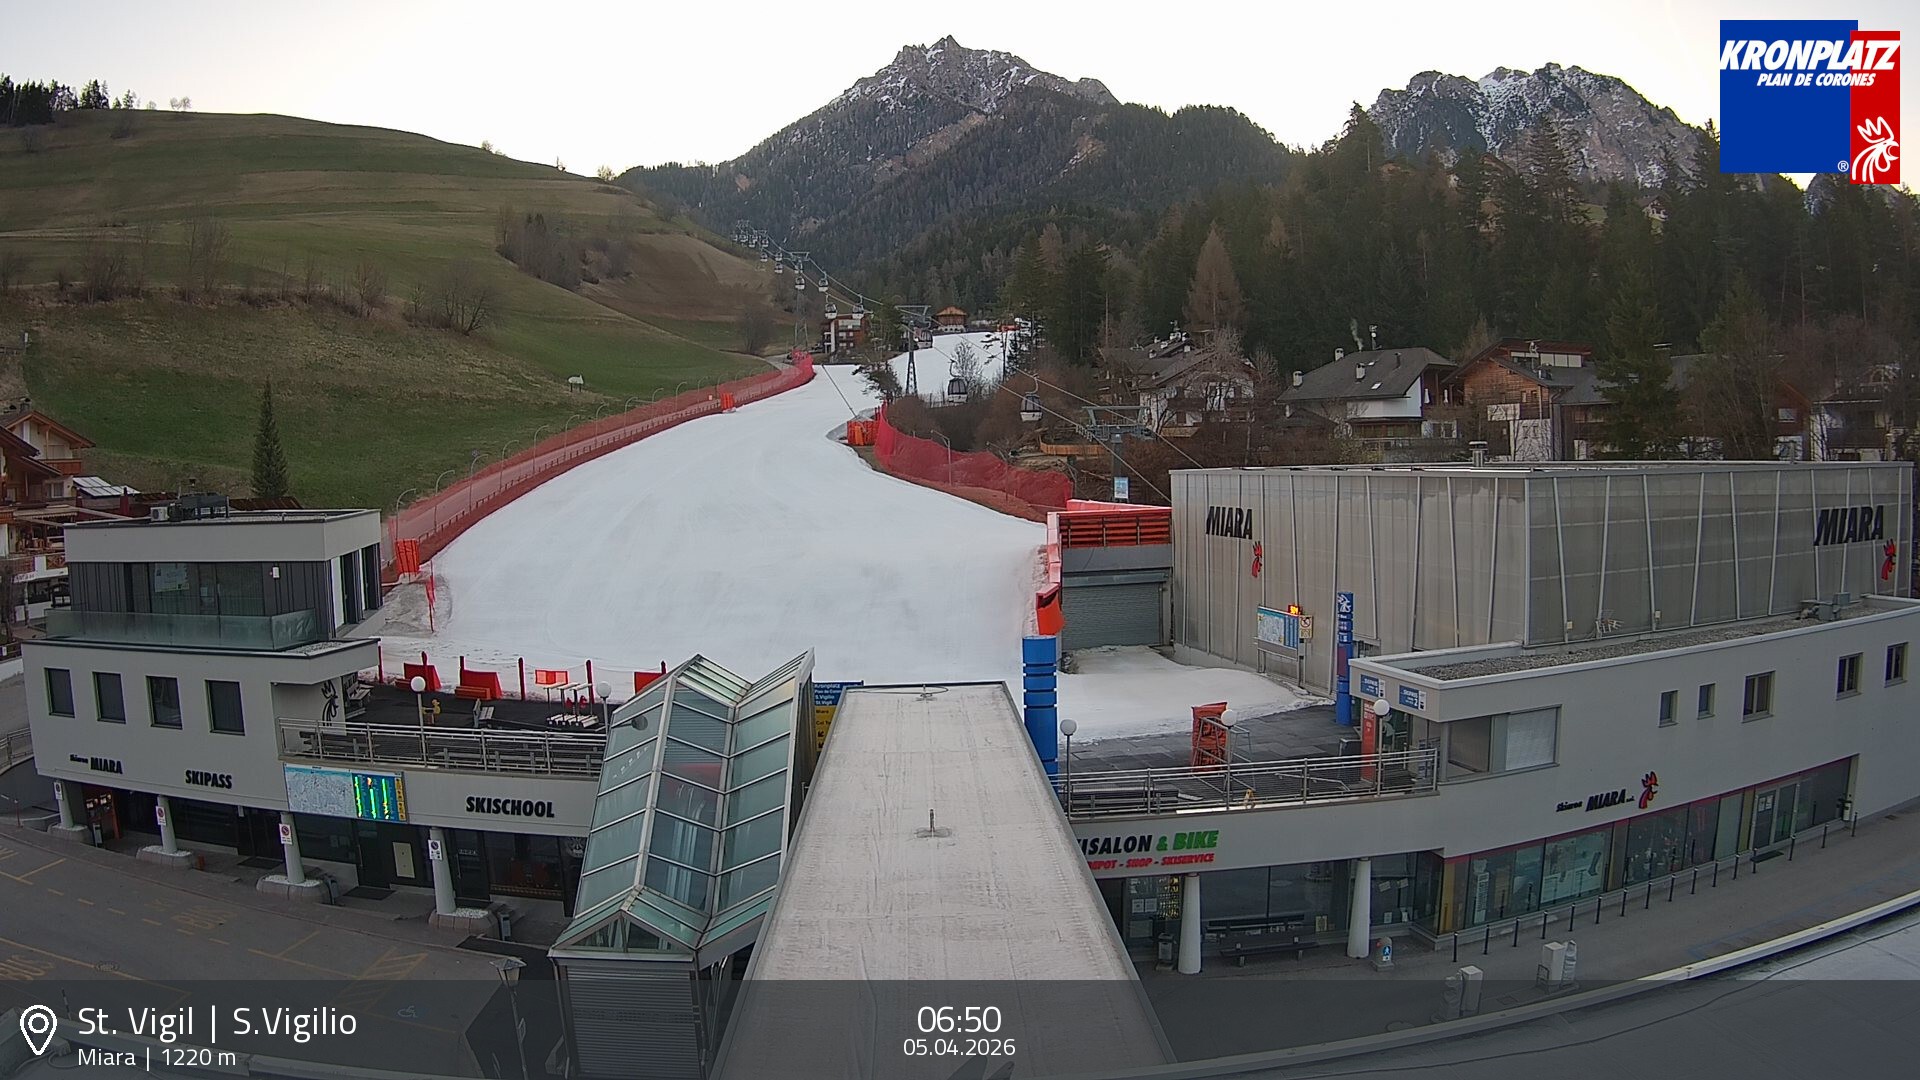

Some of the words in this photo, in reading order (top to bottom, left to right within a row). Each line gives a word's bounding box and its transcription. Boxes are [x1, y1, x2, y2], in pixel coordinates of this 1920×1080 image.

[1206, 505, 1253, 540] MIARA
[1814, 505, 1884, 546] MIARA
[91, 757, 123, 775] MIARA
[185, 769, 232, 789] SKIPASS
[466, 796, 555, 818] SKISCHOOL
[1585, 789, 1626, 811] MIARA
[1077, 835, 1152, 856] ISALON
[1156, 836, 1168, 852] &
[1172, 830, 1219, 850] BIKE
[1126, 857, 1153, 869] SHOP
[1161, 853, 1215, 866] SKISERVICE
